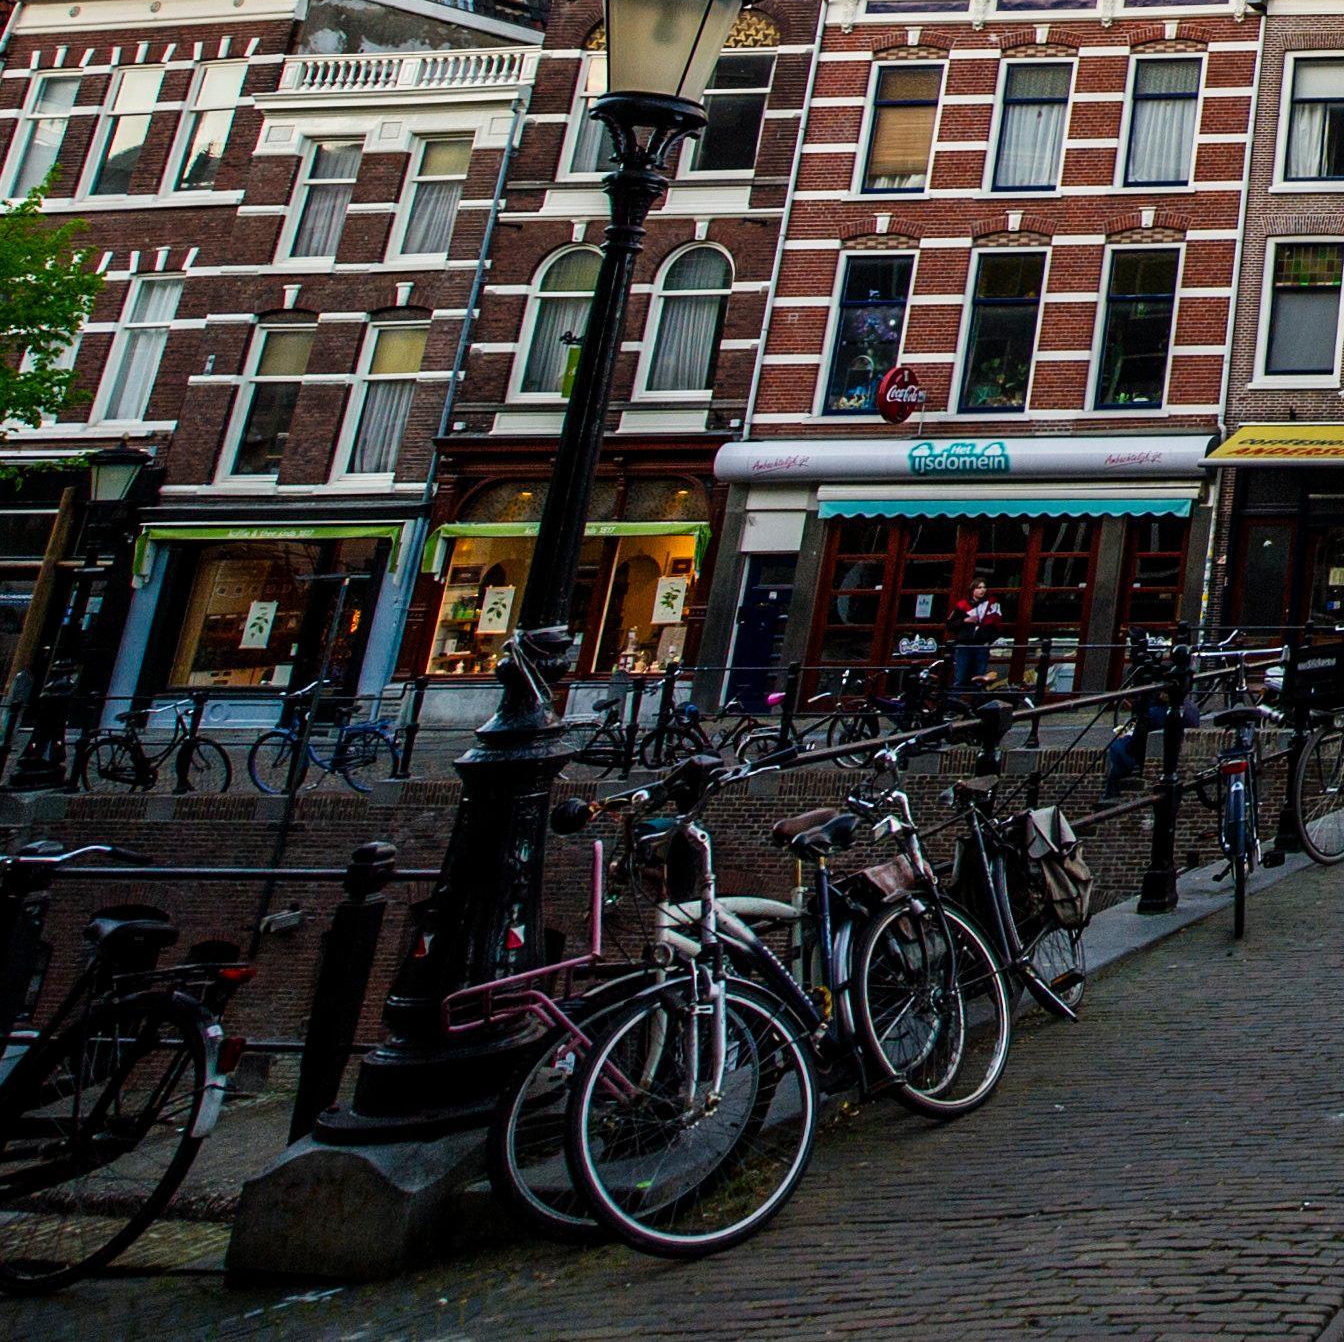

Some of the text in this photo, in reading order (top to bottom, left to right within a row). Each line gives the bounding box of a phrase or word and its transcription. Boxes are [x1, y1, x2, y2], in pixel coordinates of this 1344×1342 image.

[952, 444, 972, 455] Het
[914, 454, 1006, 474] ijsdomein
[599, 525, 616, 535] 1817
